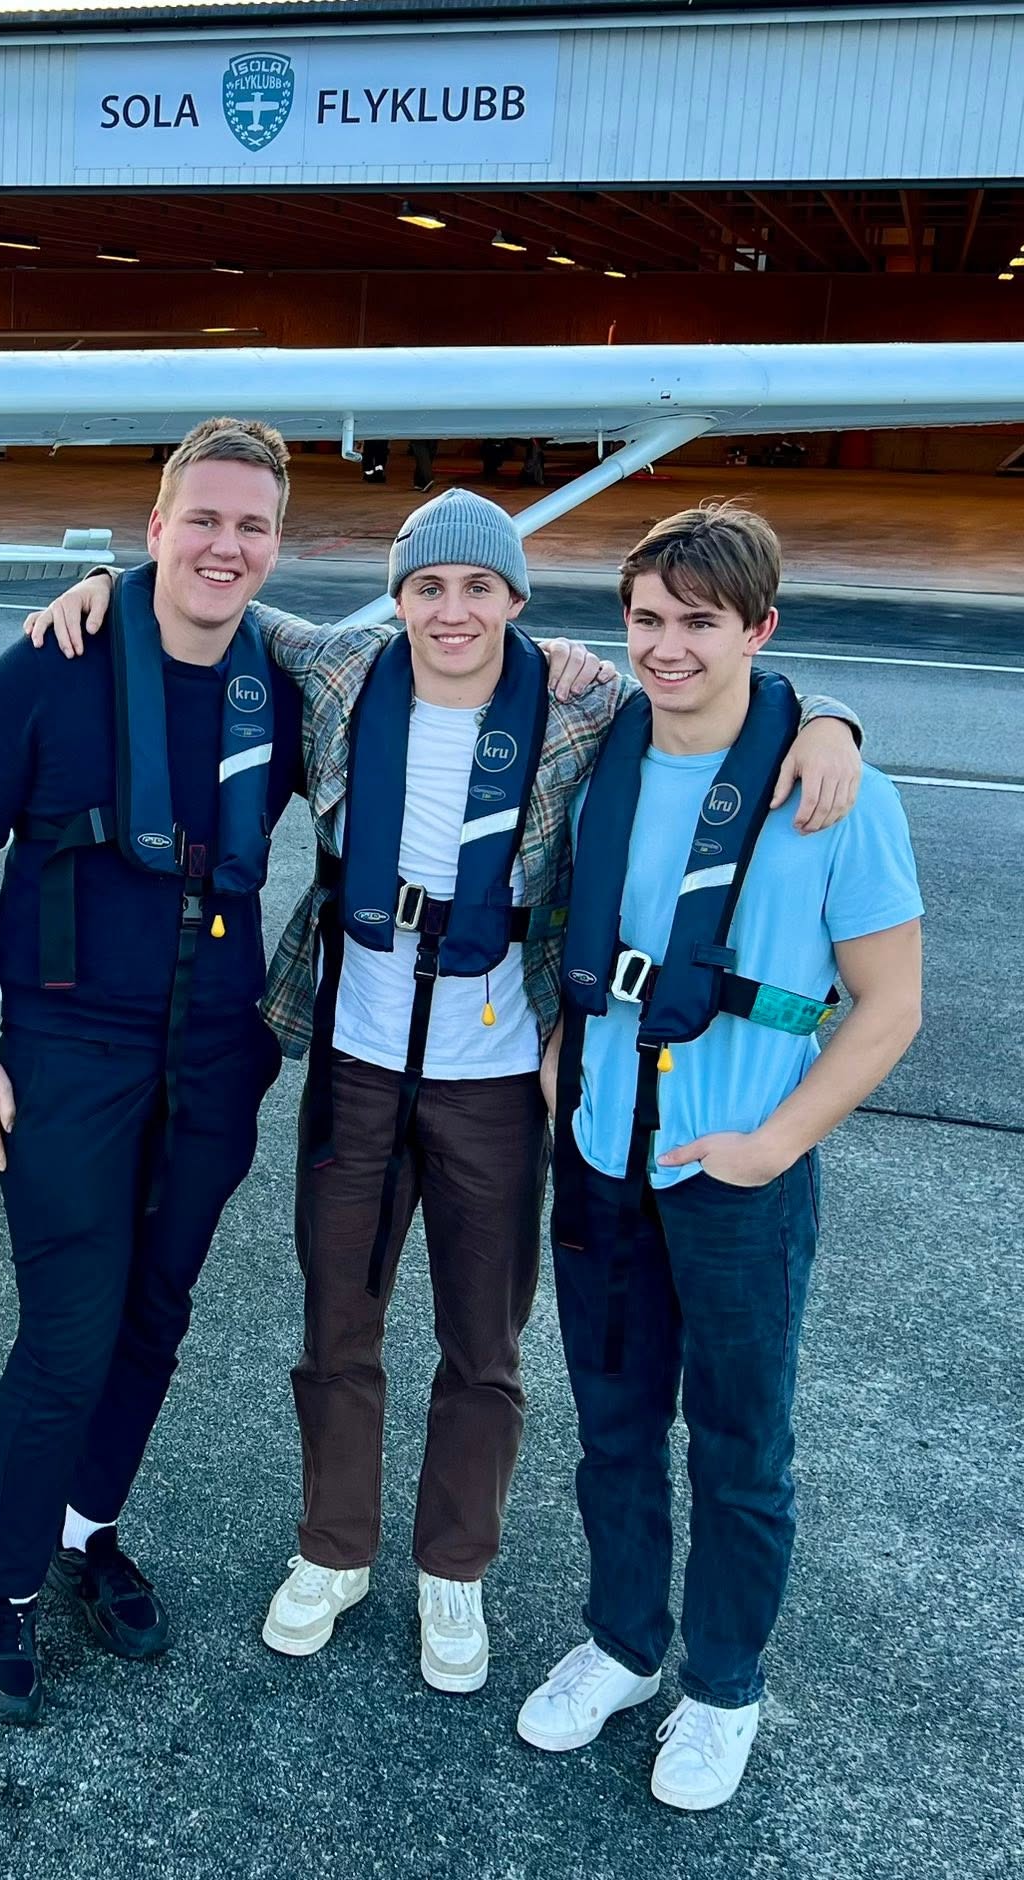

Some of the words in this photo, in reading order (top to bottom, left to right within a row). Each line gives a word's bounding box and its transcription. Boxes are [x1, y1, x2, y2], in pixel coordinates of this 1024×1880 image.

[238, 60, 282, 75] SOLA
[235, 74, 282, 90] FLYKLUBB
[100, 93, 200, 129] SOLA
[317, 85, 526, 124] FLYKLUBB
[235, 679, 259, 701] kru
[482, 735, 509, 759] kru
[708, 787, 733, 812] kru
